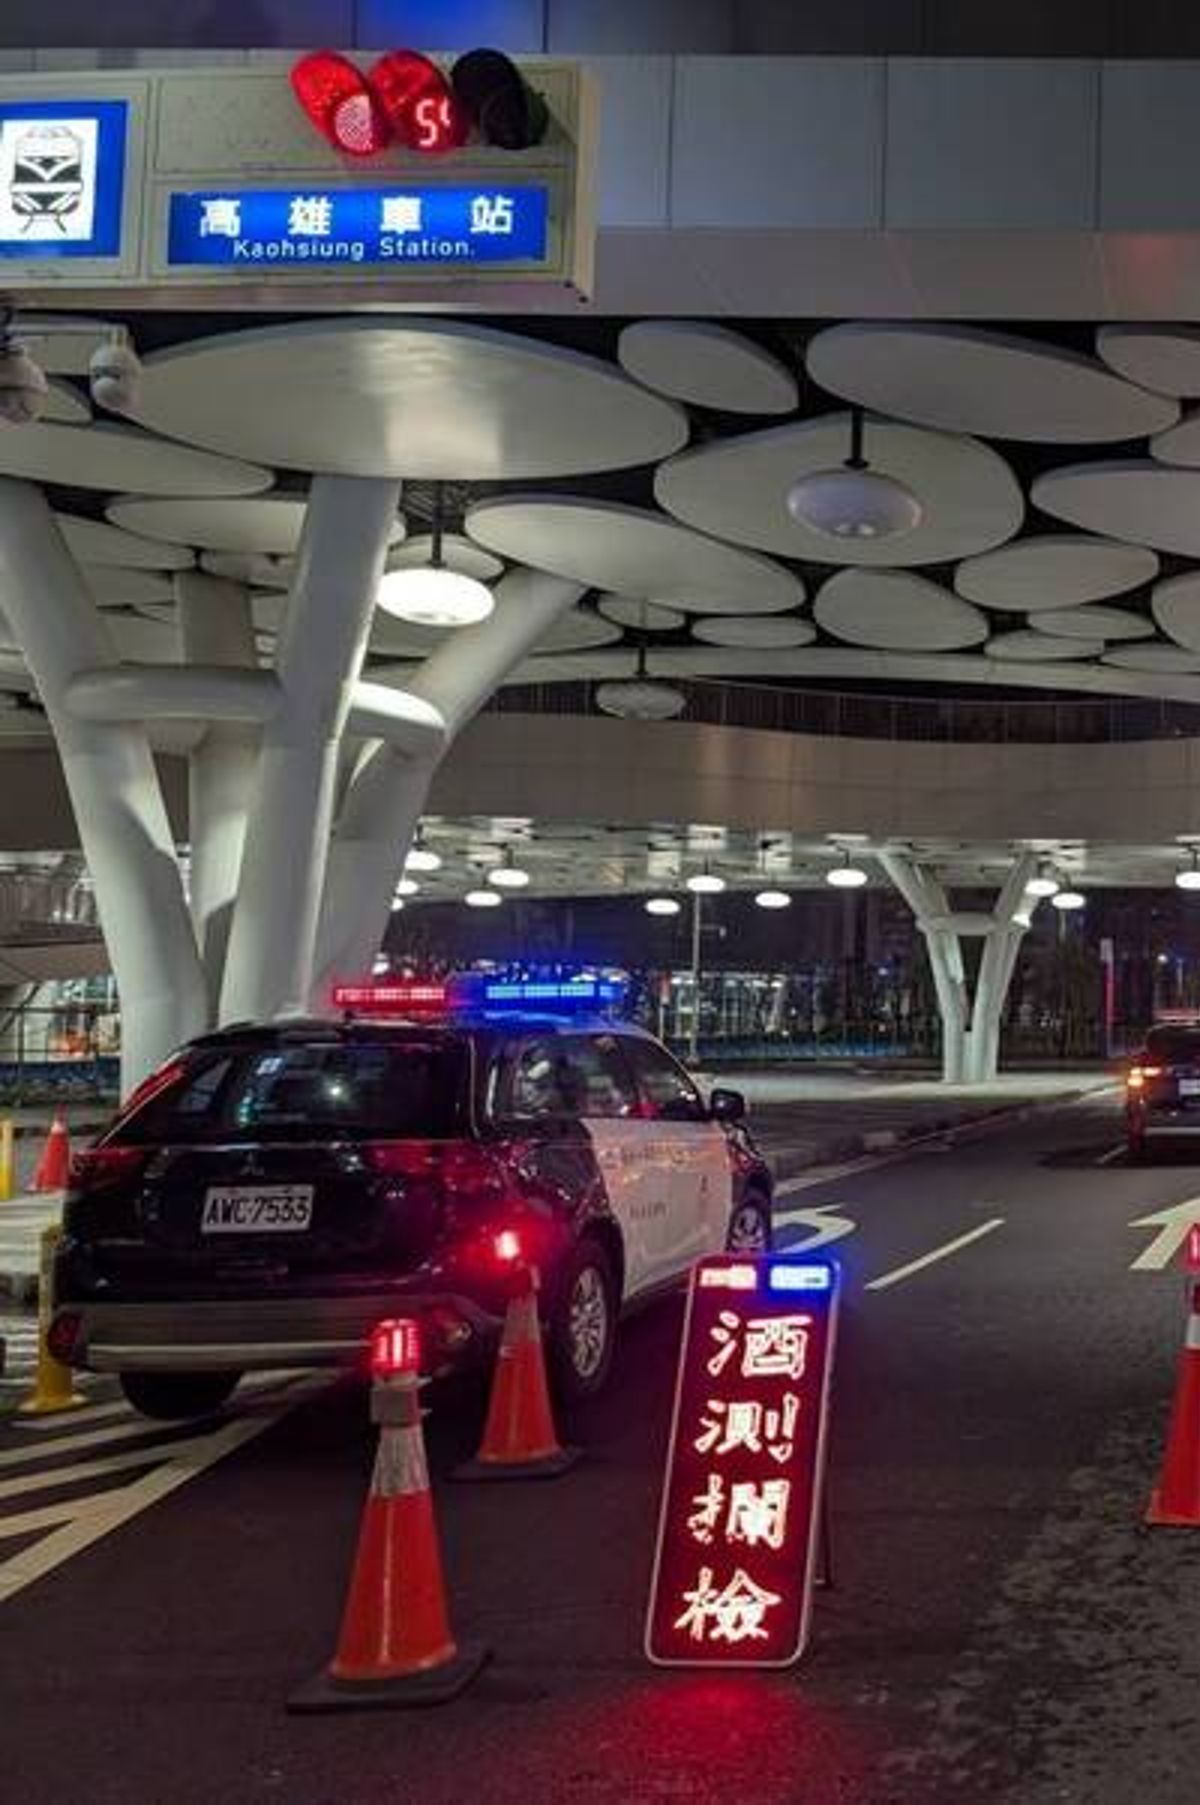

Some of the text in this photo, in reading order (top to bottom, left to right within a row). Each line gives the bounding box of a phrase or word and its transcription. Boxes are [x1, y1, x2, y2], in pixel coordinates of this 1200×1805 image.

[200, 196, 514, 237] 高雄車站
[233, 239, 365, 261] Kaohsiung
[673, 1311, 813, 1642] 酒測攔檢
